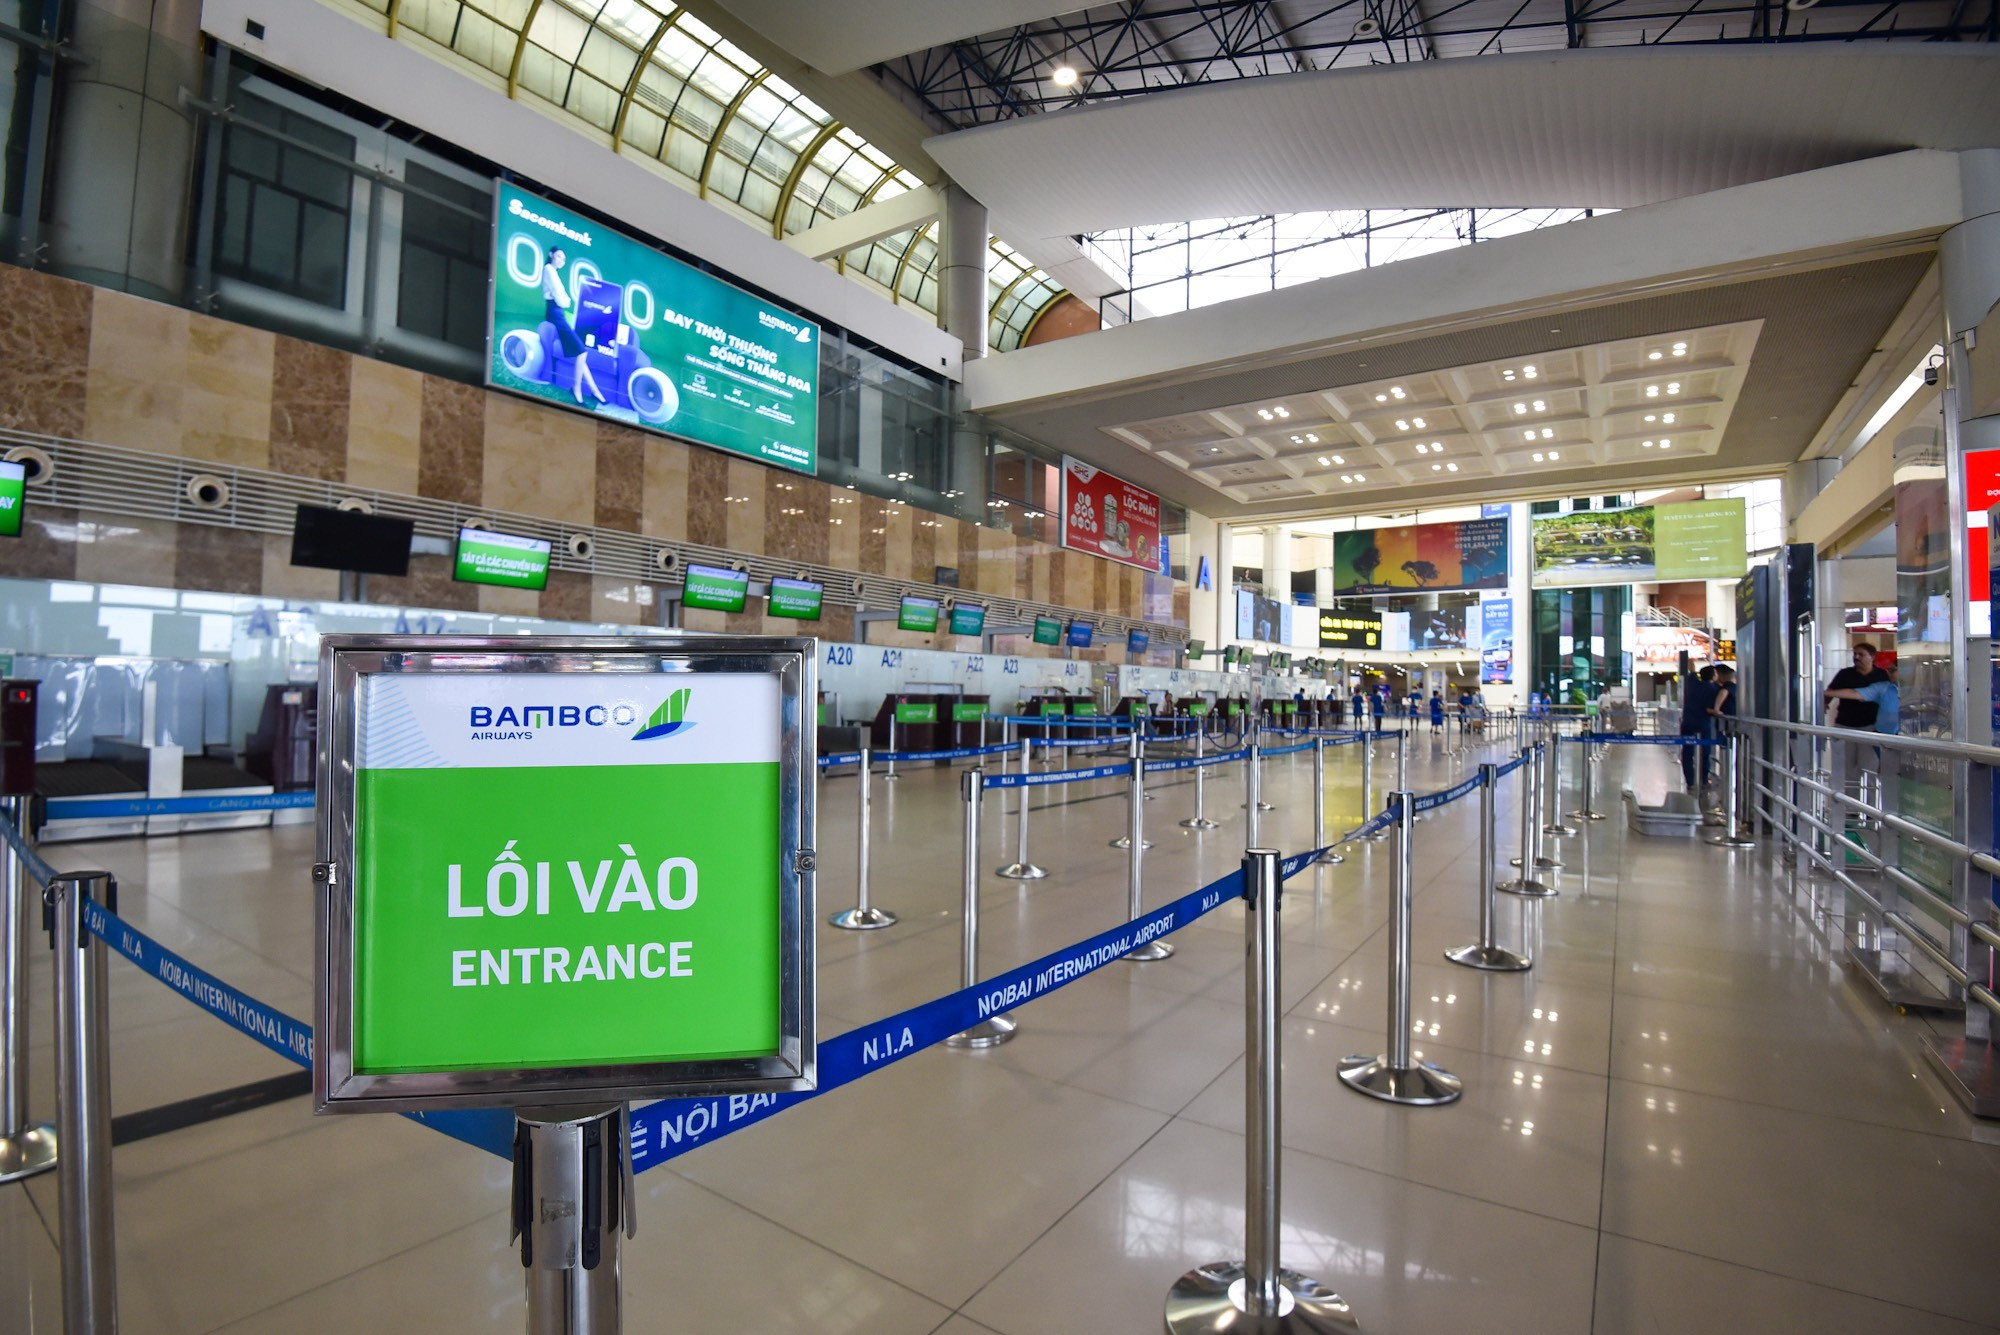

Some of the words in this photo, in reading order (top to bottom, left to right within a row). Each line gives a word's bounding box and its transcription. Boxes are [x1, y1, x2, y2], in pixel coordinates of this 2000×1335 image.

[508, 199, 592, 247] Sacombank
[663, 308, 694, 330] BAY
[694, 321, 727, 343] THỜI
[727, 335, 778, 364] THƯỢNG
[759, 311, 798, 335] BAMBOO
[709, 345, 745, 368] SỐNG
[786, 375, 811, 393] HOA
[1123, 495, 1138, 511] LỘC
[1139, 501, 1157, 518] PHÁT
[1197, 555, 1212, 592] A
[827, 645, 853, 666] A20
[881, 649, 903, 668] A21
[966, 656, 984, 673] A22
[1003, 658, 1019, 674] A23
[469, 705, 635, 729] BAMBOO
[471, 732, 533, 740] AIRWAYS
[448, 840, 550, 918] LỐI
[567, 843, 699, 914] VÀO
[452, 940, 694, 987] ENTRANCE
[863, 1027, 914, 1065] N.I.A
[977, 977, 1032, 1019] NOIBAI
[1035, 935, 1131, 993] INTERNATIONAL
[1131, 912, 1175, 948] AIRPORT
[1202, 890, 1220, 912] N.I.A
[122, 931, 143, 960] N.I.A
[159, 957, 194, 993] NOIBAI
[194, 977, 285, 1045] INTERNATIONAL
[660, 1101, 718, 1149] NỘI
